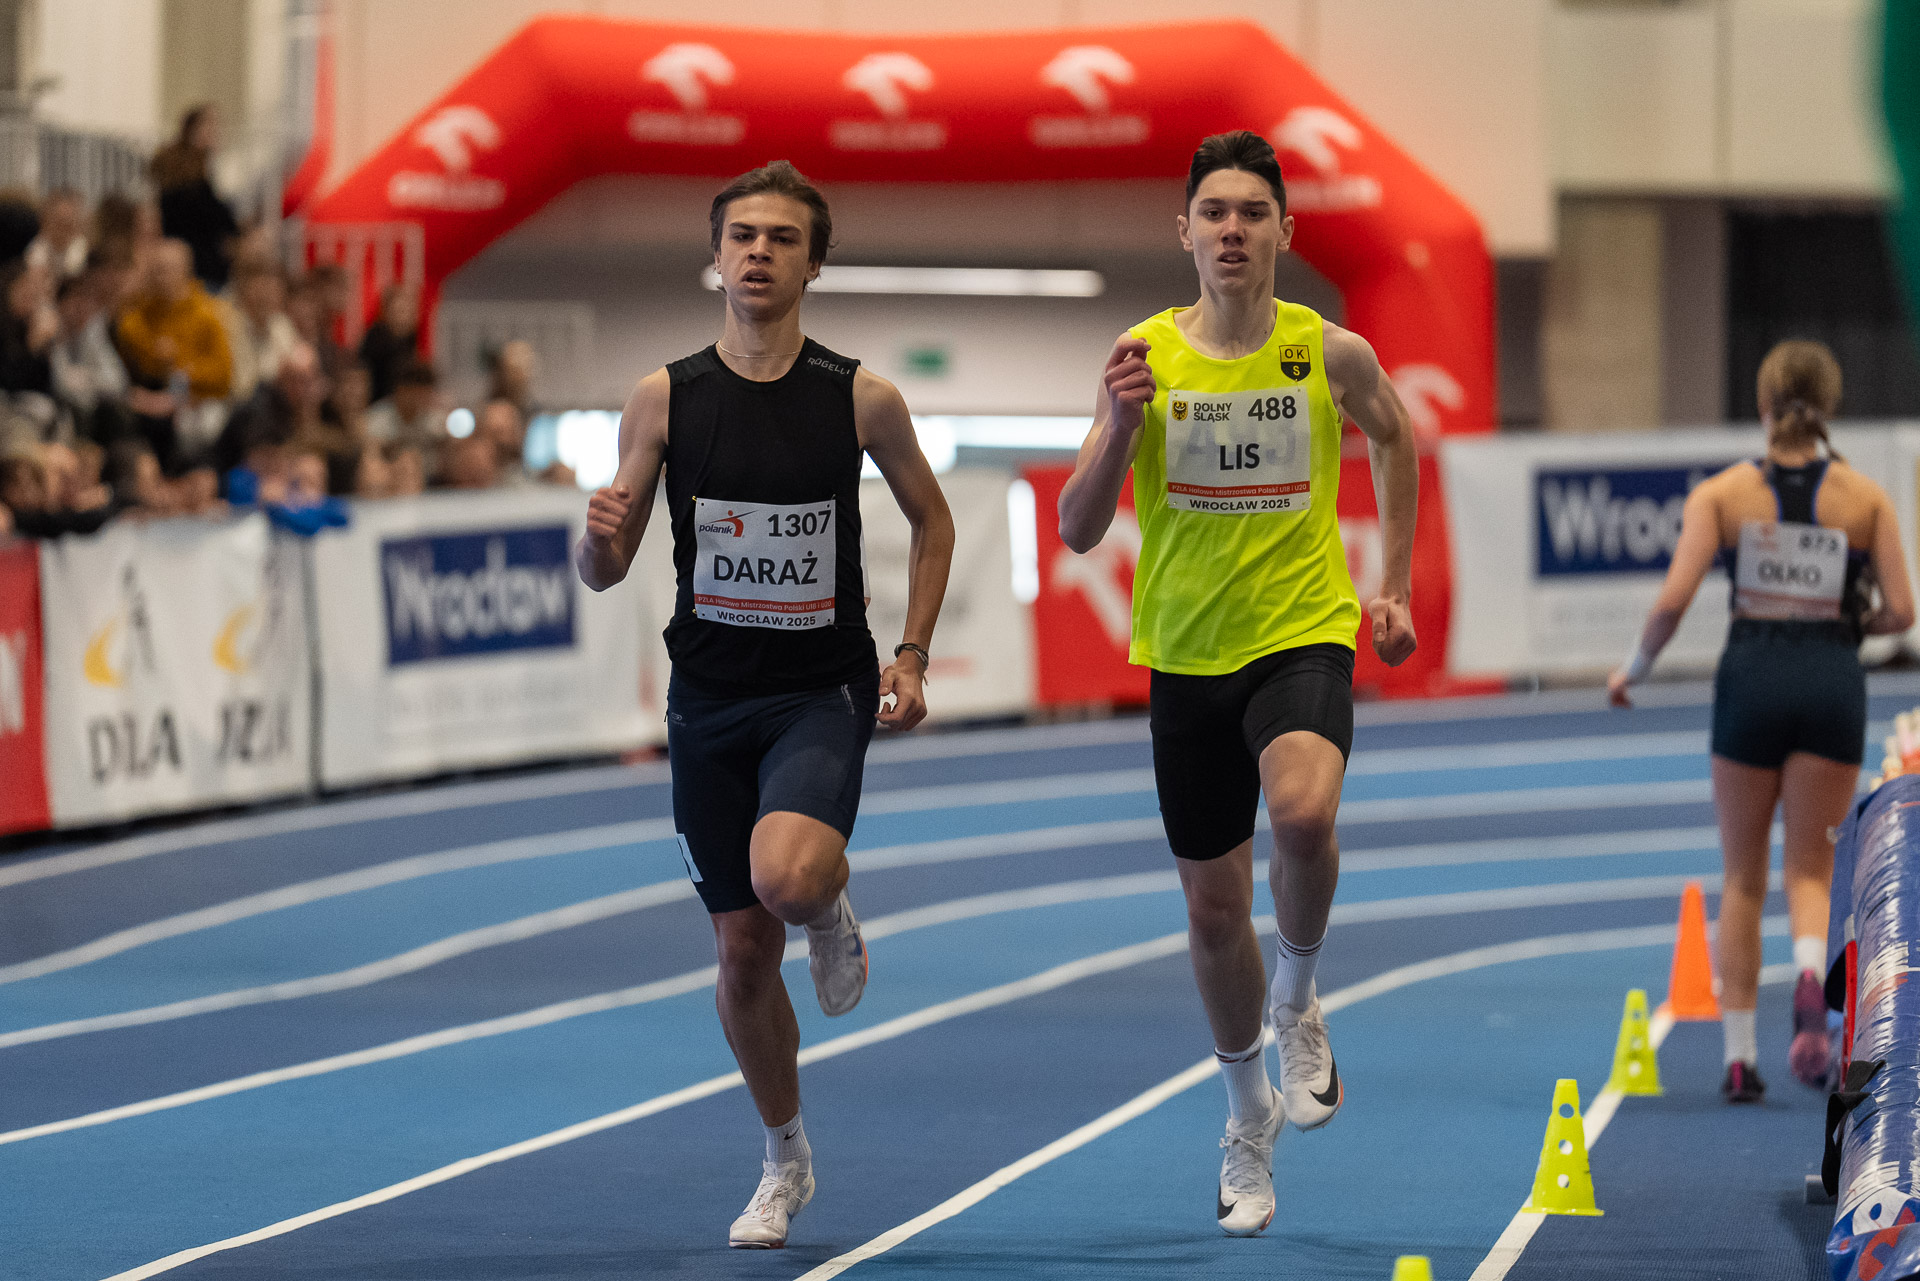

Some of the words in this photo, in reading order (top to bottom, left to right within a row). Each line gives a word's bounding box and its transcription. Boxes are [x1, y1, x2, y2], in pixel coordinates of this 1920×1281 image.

[807, 356, 851, 375] ROGELLI
[1193, 402, 1232, 412] DOLNY
[1247, 395, 1297, 422] 488
[1193, 410, 1230, 423] ŚLĄSK
[1219, 443, 1260, 471] LIS
[1189, 487, 1214, 496] Halowe
[1215, 488, 1257, 496] Mistrzostwa
[1257, 486, 1279, 494] Polski
[1294, 483, 1307, 491] U20
[1189, 499, 1258, 511] WROCŁAW
[1261, 498, 1291, 509] 2025
[698, 523, 733, 534] polanik
[767, 509, 832, 537] 1307
[713, 550, 818, 585] DARAŻ
[715, 599, 740, 608] Halowe
[740, 601, 782, 611] Mistrzostwa
[716, 610, 783, 626] WROCŁAW
[786, 616, 816, 627] 2025
